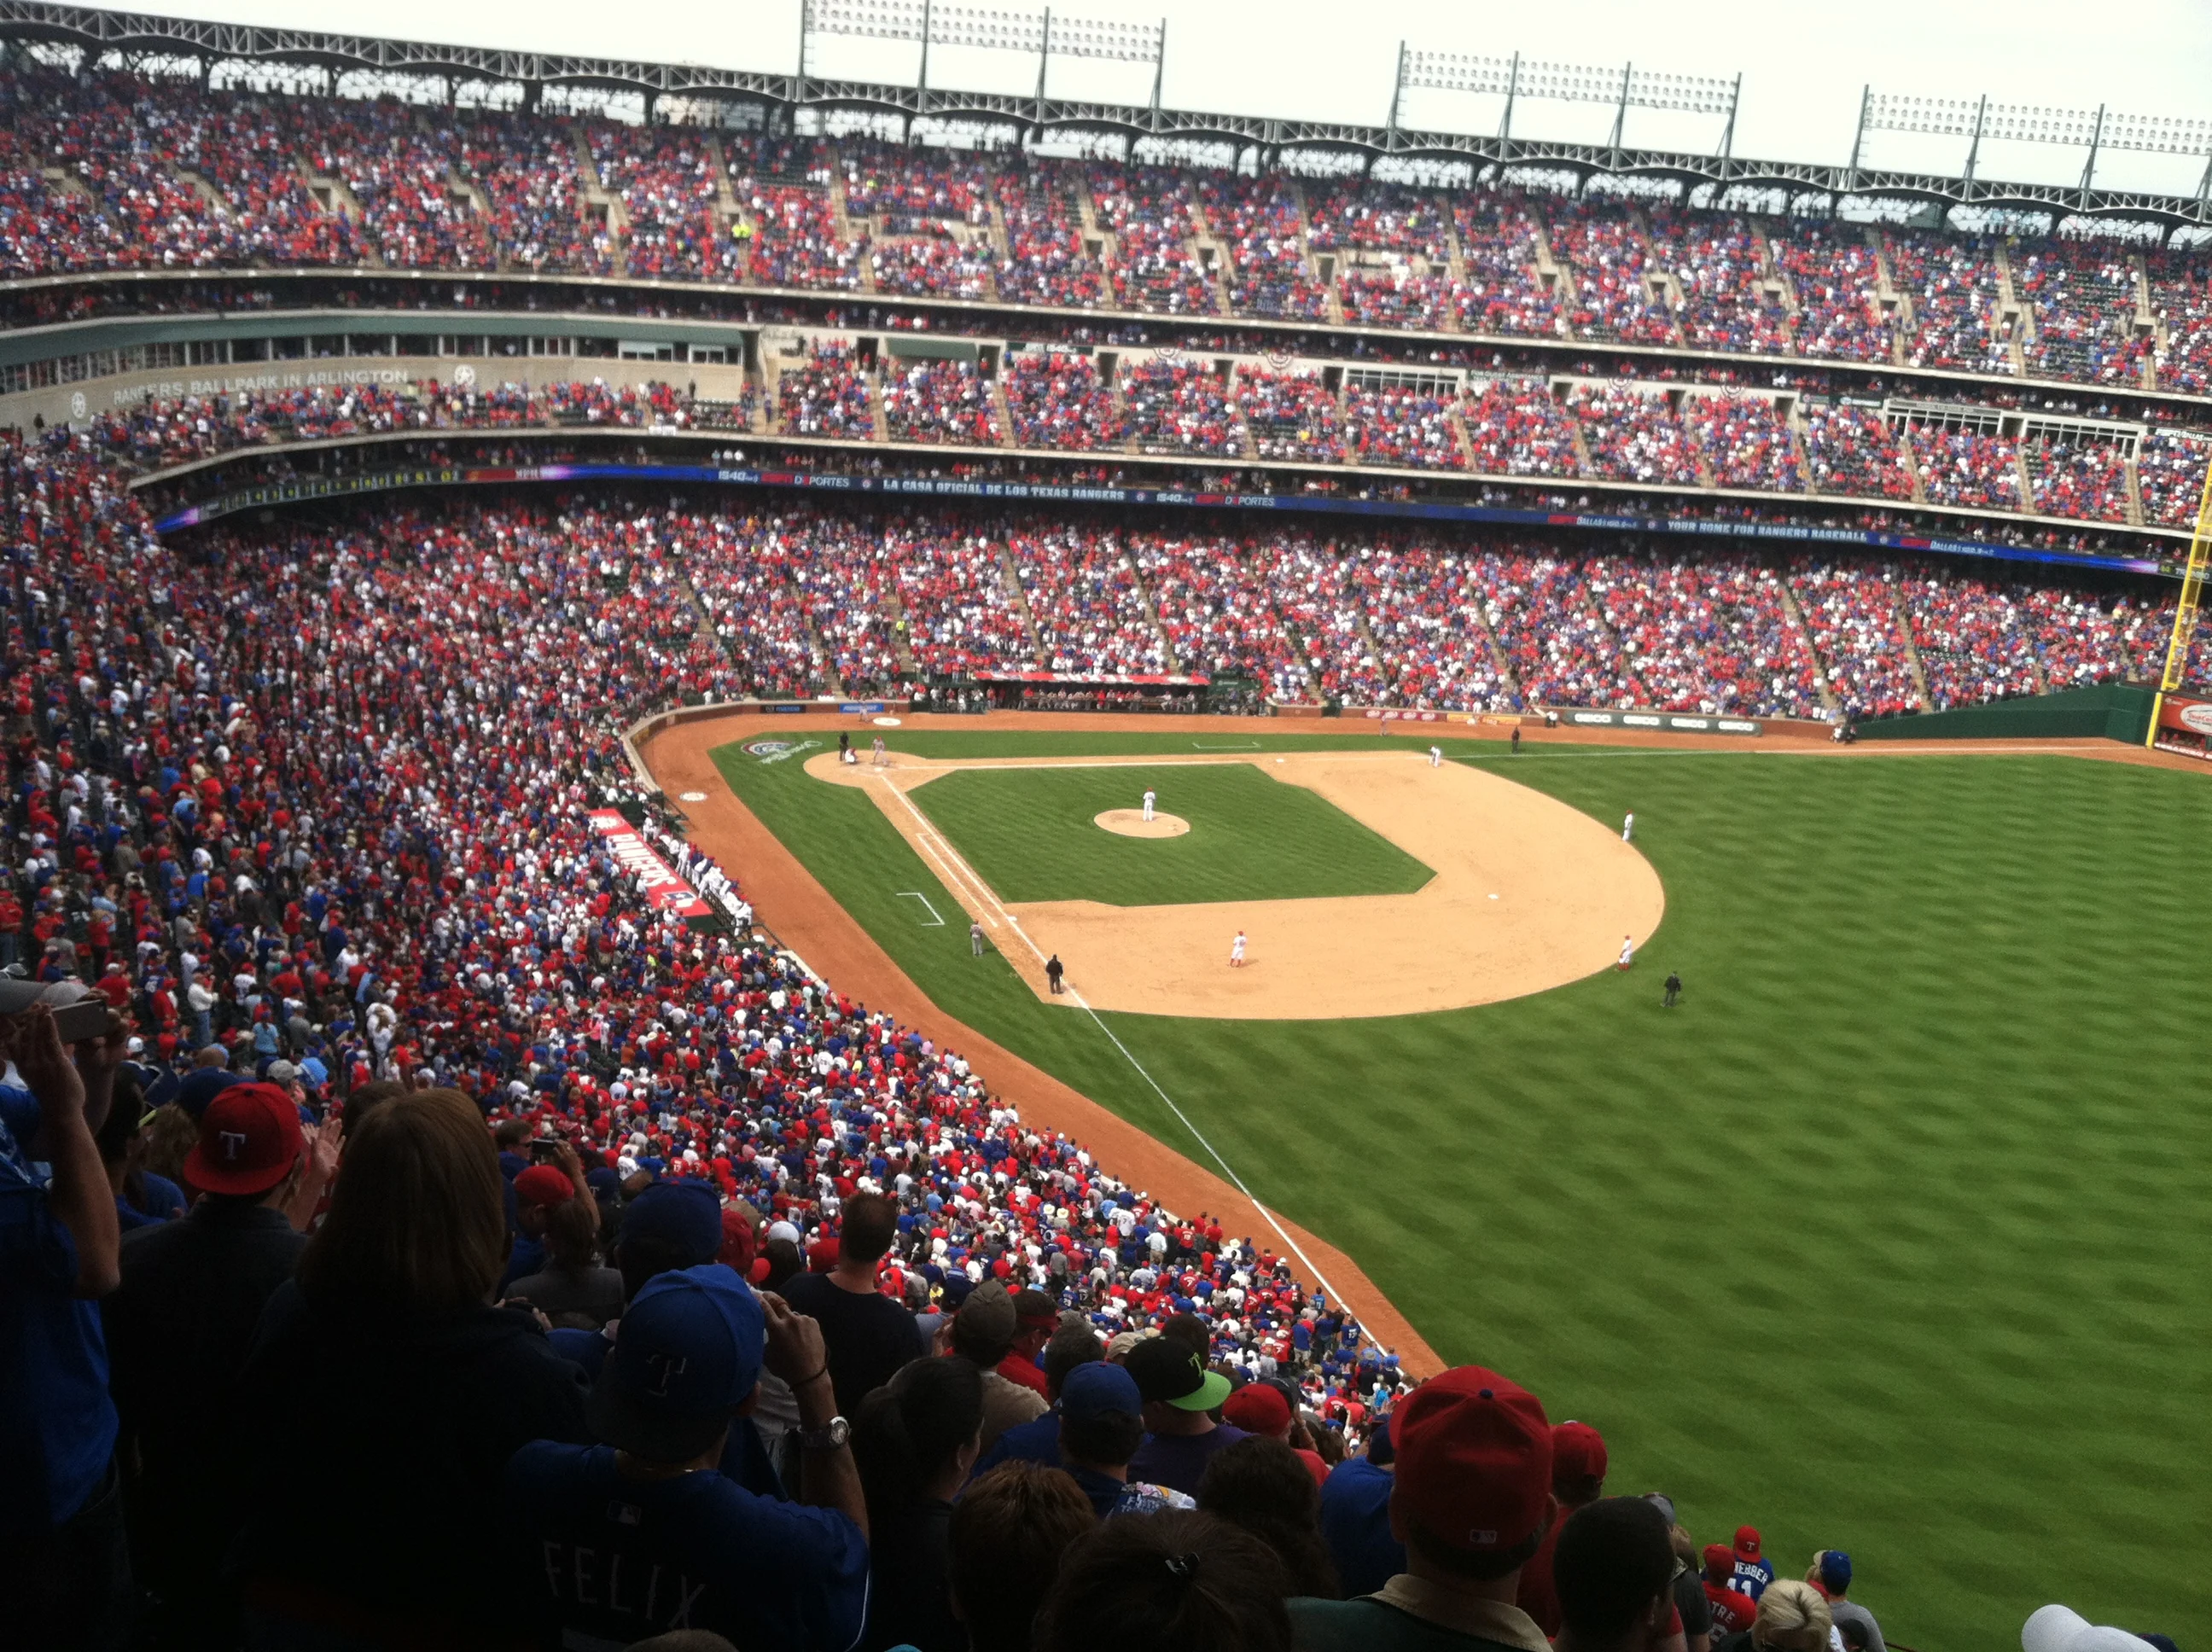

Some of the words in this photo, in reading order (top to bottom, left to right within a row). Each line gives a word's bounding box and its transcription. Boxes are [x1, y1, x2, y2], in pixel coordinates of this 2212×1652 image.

[190, 375, 277, 395] BALLPARK
[283, 374, 299, 387] IN
[307, 369, 408, 385] ARLINGTON
[882, 480, 899, 490] LA
[902, 480, 933, 492] CASA
[936, 481, 982, 494] OFICIAL
[986, 484, 1002, 495] DE
[1004, 485, 1027, 496] LOS
[1031, 486, 1068, 497] TEXAS
[1072, 489, 1126, 500] RANGERS
[1668, 521, 1696, 532] YOUR
[1699, 522, 1731, 532] HOME
[1732, 524, 1755, 534] FOR
[1758, 526, 1809, 538] RANGERS
[1811, 527, 1868, 542] BASEBALL
[219, 1131, 246, 1160] T
[1746, 1541, 1755, 1551] T
[542, 1539, 707, 1629] FELIX
